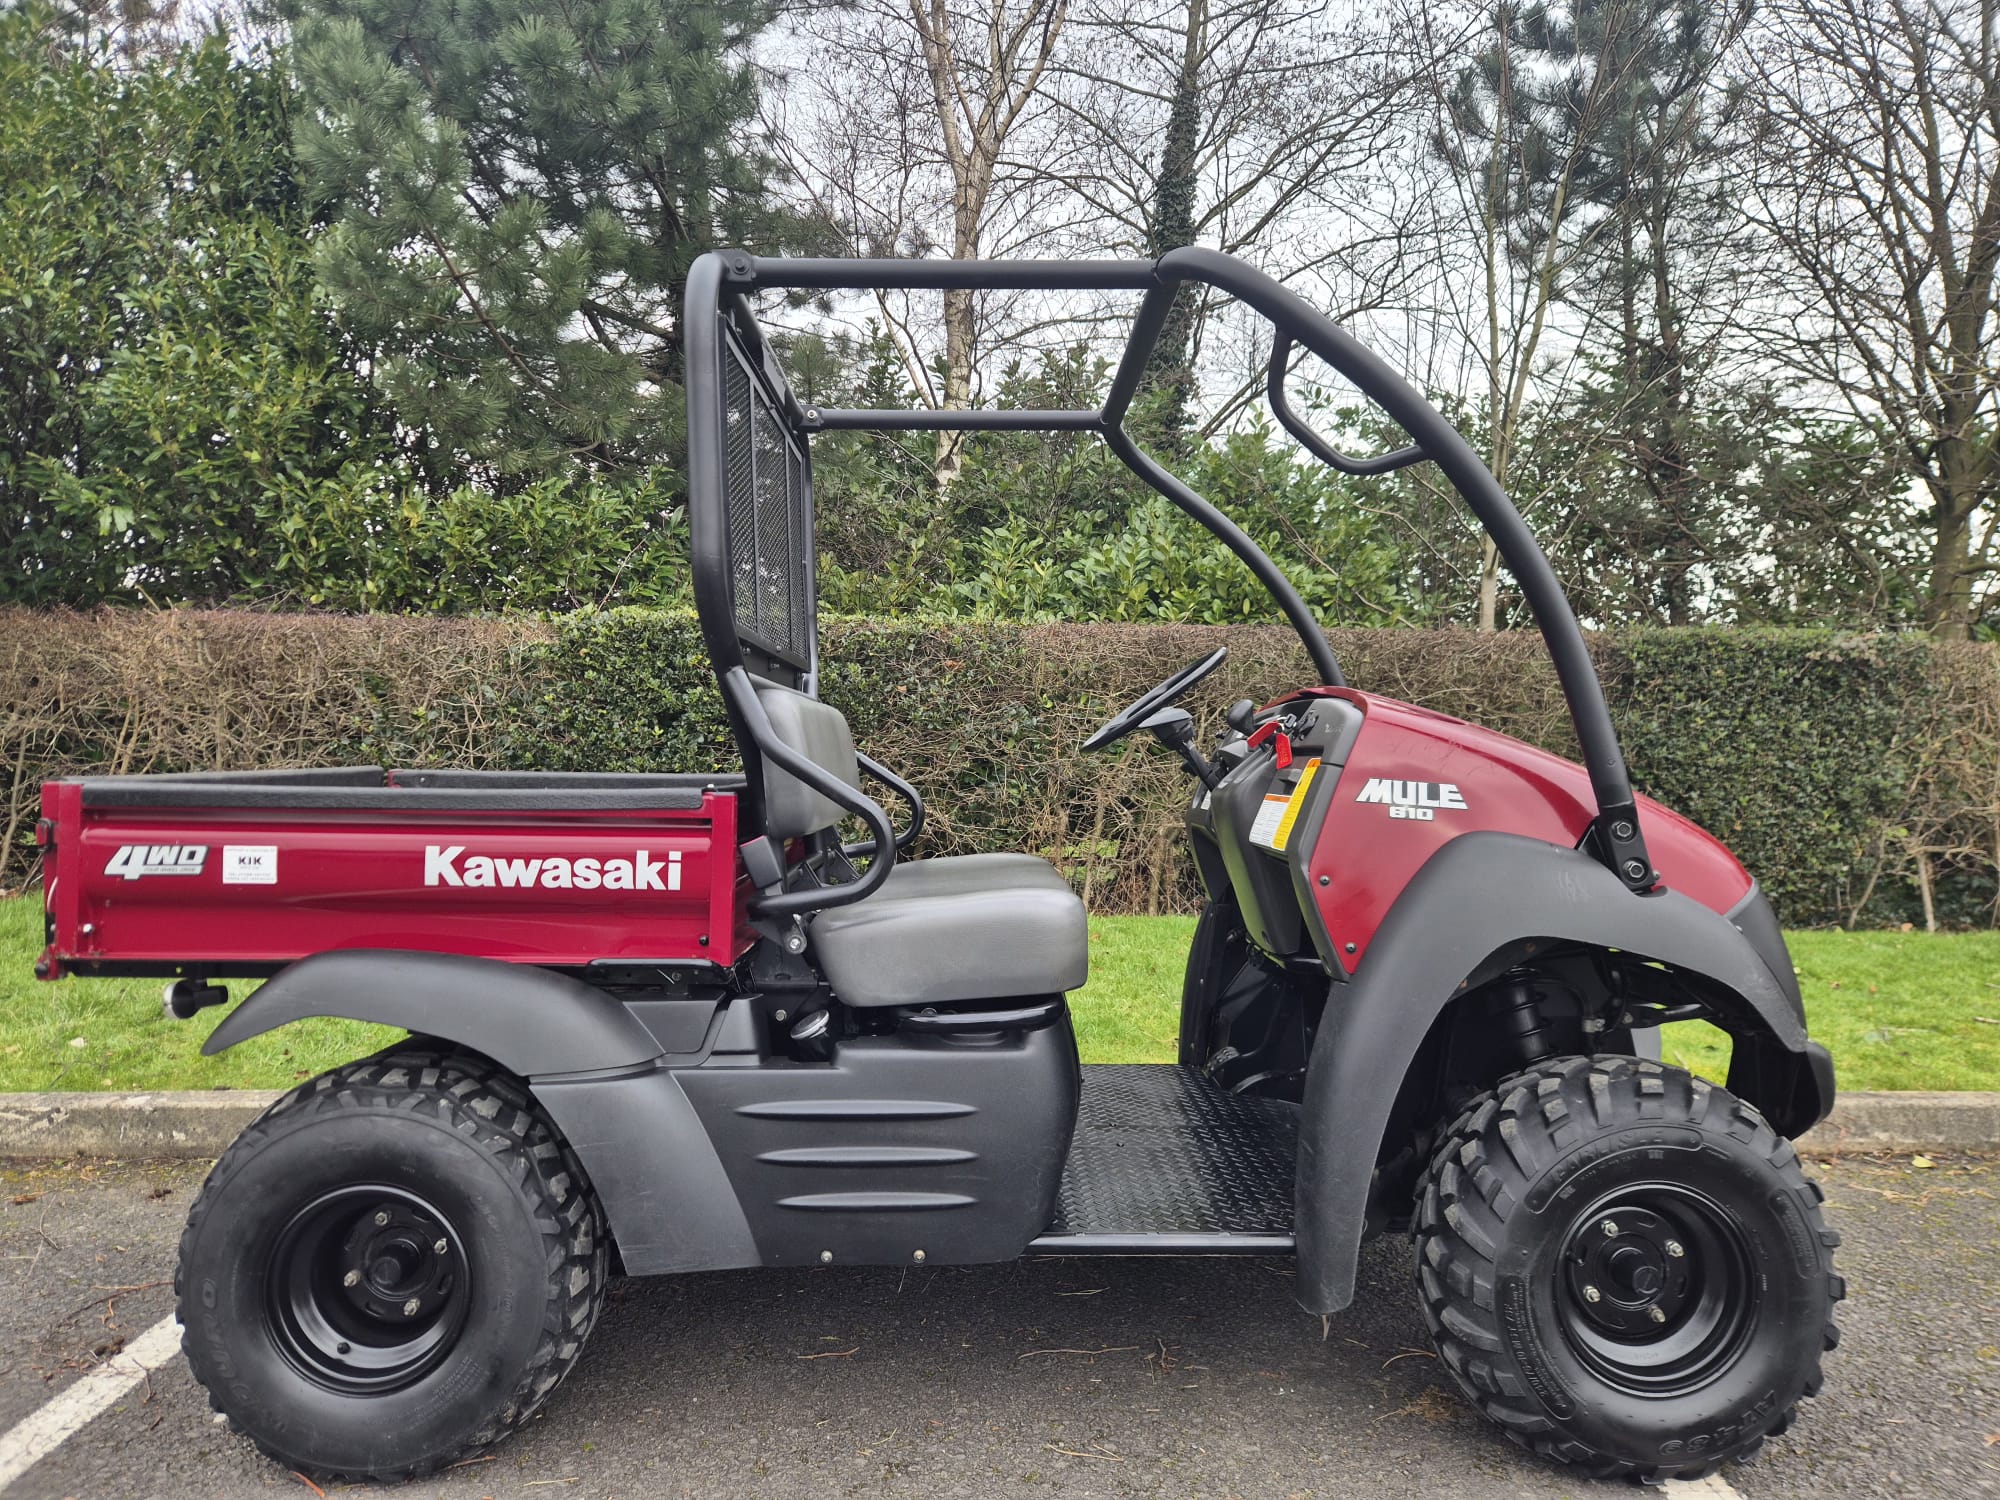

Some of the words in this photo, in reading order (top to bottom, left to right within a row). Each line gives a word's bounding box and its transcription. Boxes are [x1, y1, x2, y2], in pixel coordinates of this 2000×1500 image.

[1355, 778, 1469, 810] MULE
[104, 845, 208, 880] 4WD
[238, 856, 262, 865] KIK
[424, 845, 682, 891] Kawasaki
